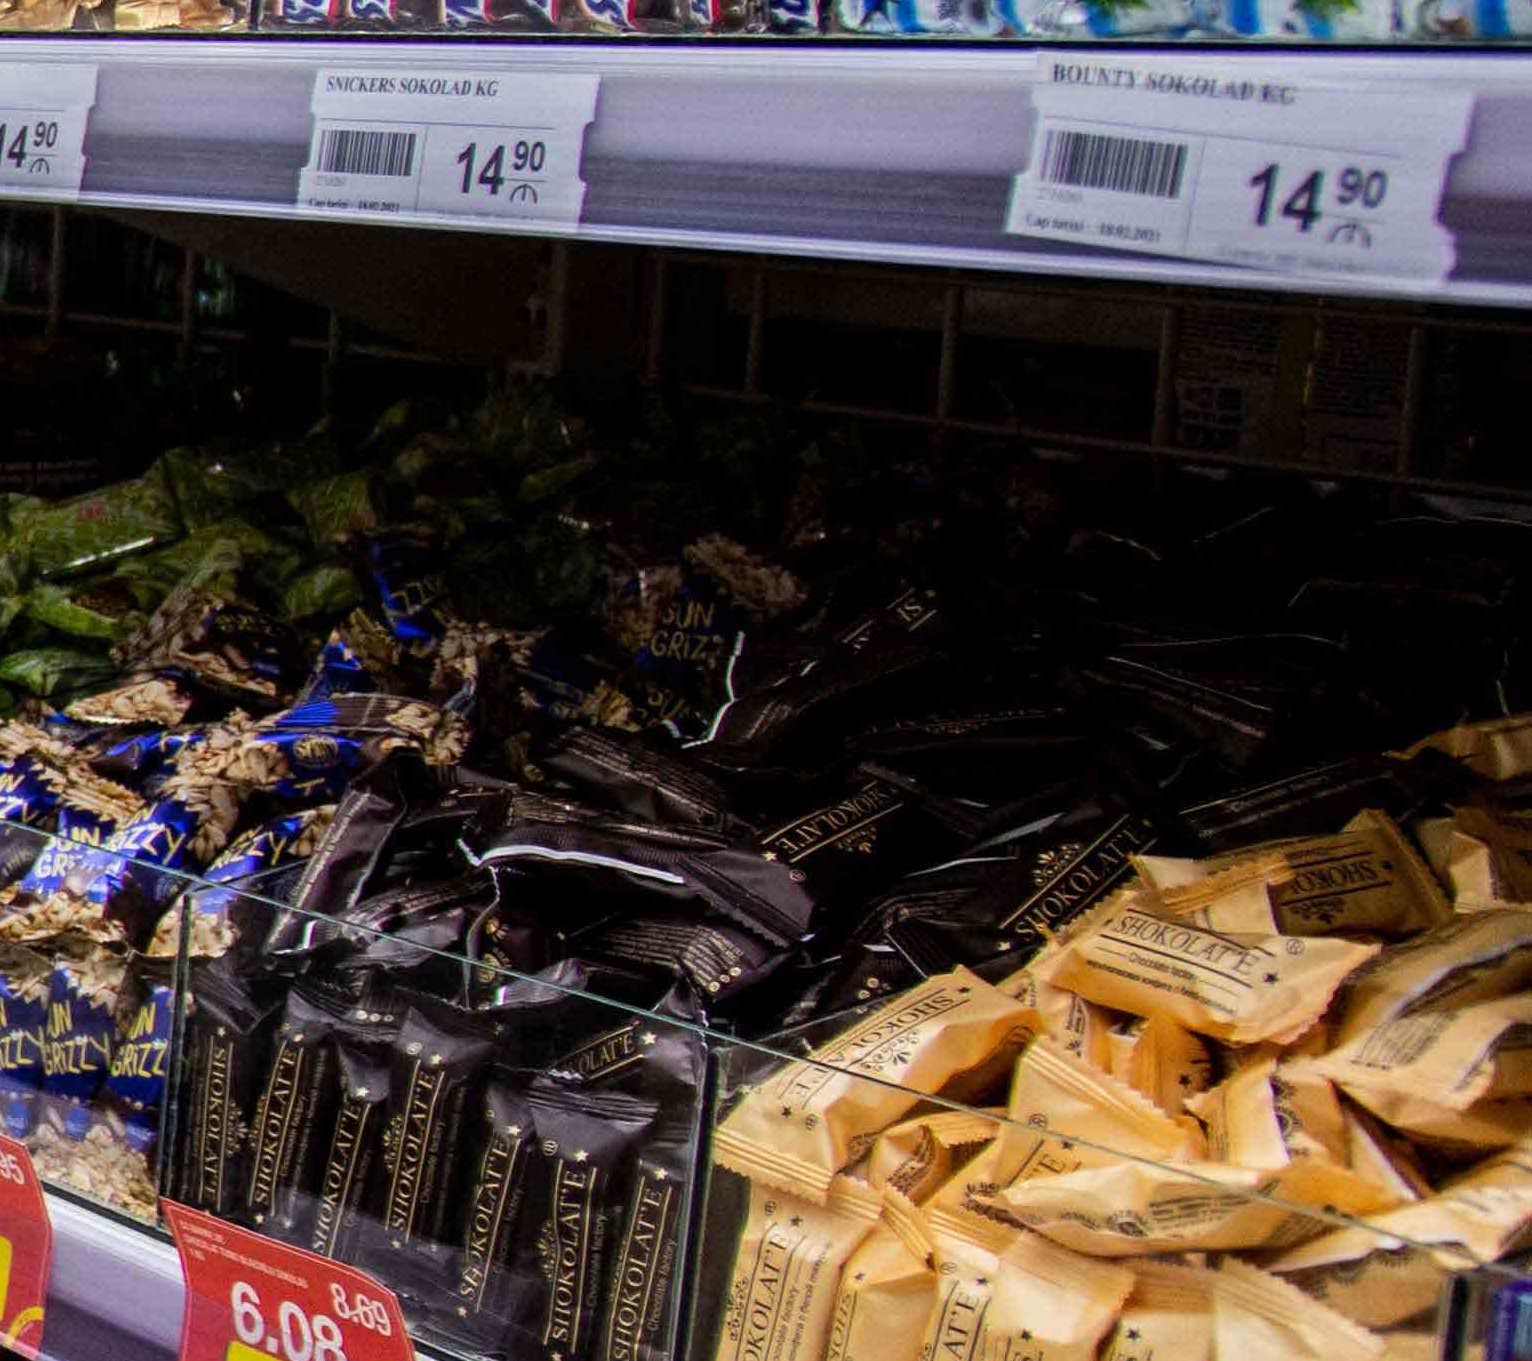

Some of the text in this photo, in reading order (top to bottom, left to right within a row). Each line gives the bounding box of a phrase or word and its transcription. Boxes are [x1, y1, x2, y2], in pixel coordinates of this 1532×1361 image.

[326, 75, 500, 98] SNICKERS SOKOLAD KG
[1051, 62, 1296, 106] BOUNTY SOKOLAD KG
[32, 120, 59, 149] 90
[455, 140, 547, 196] 14 90
[1249, 162, 1388, 233] 14 90
[330, 1282, 392, 1337] 8.69
